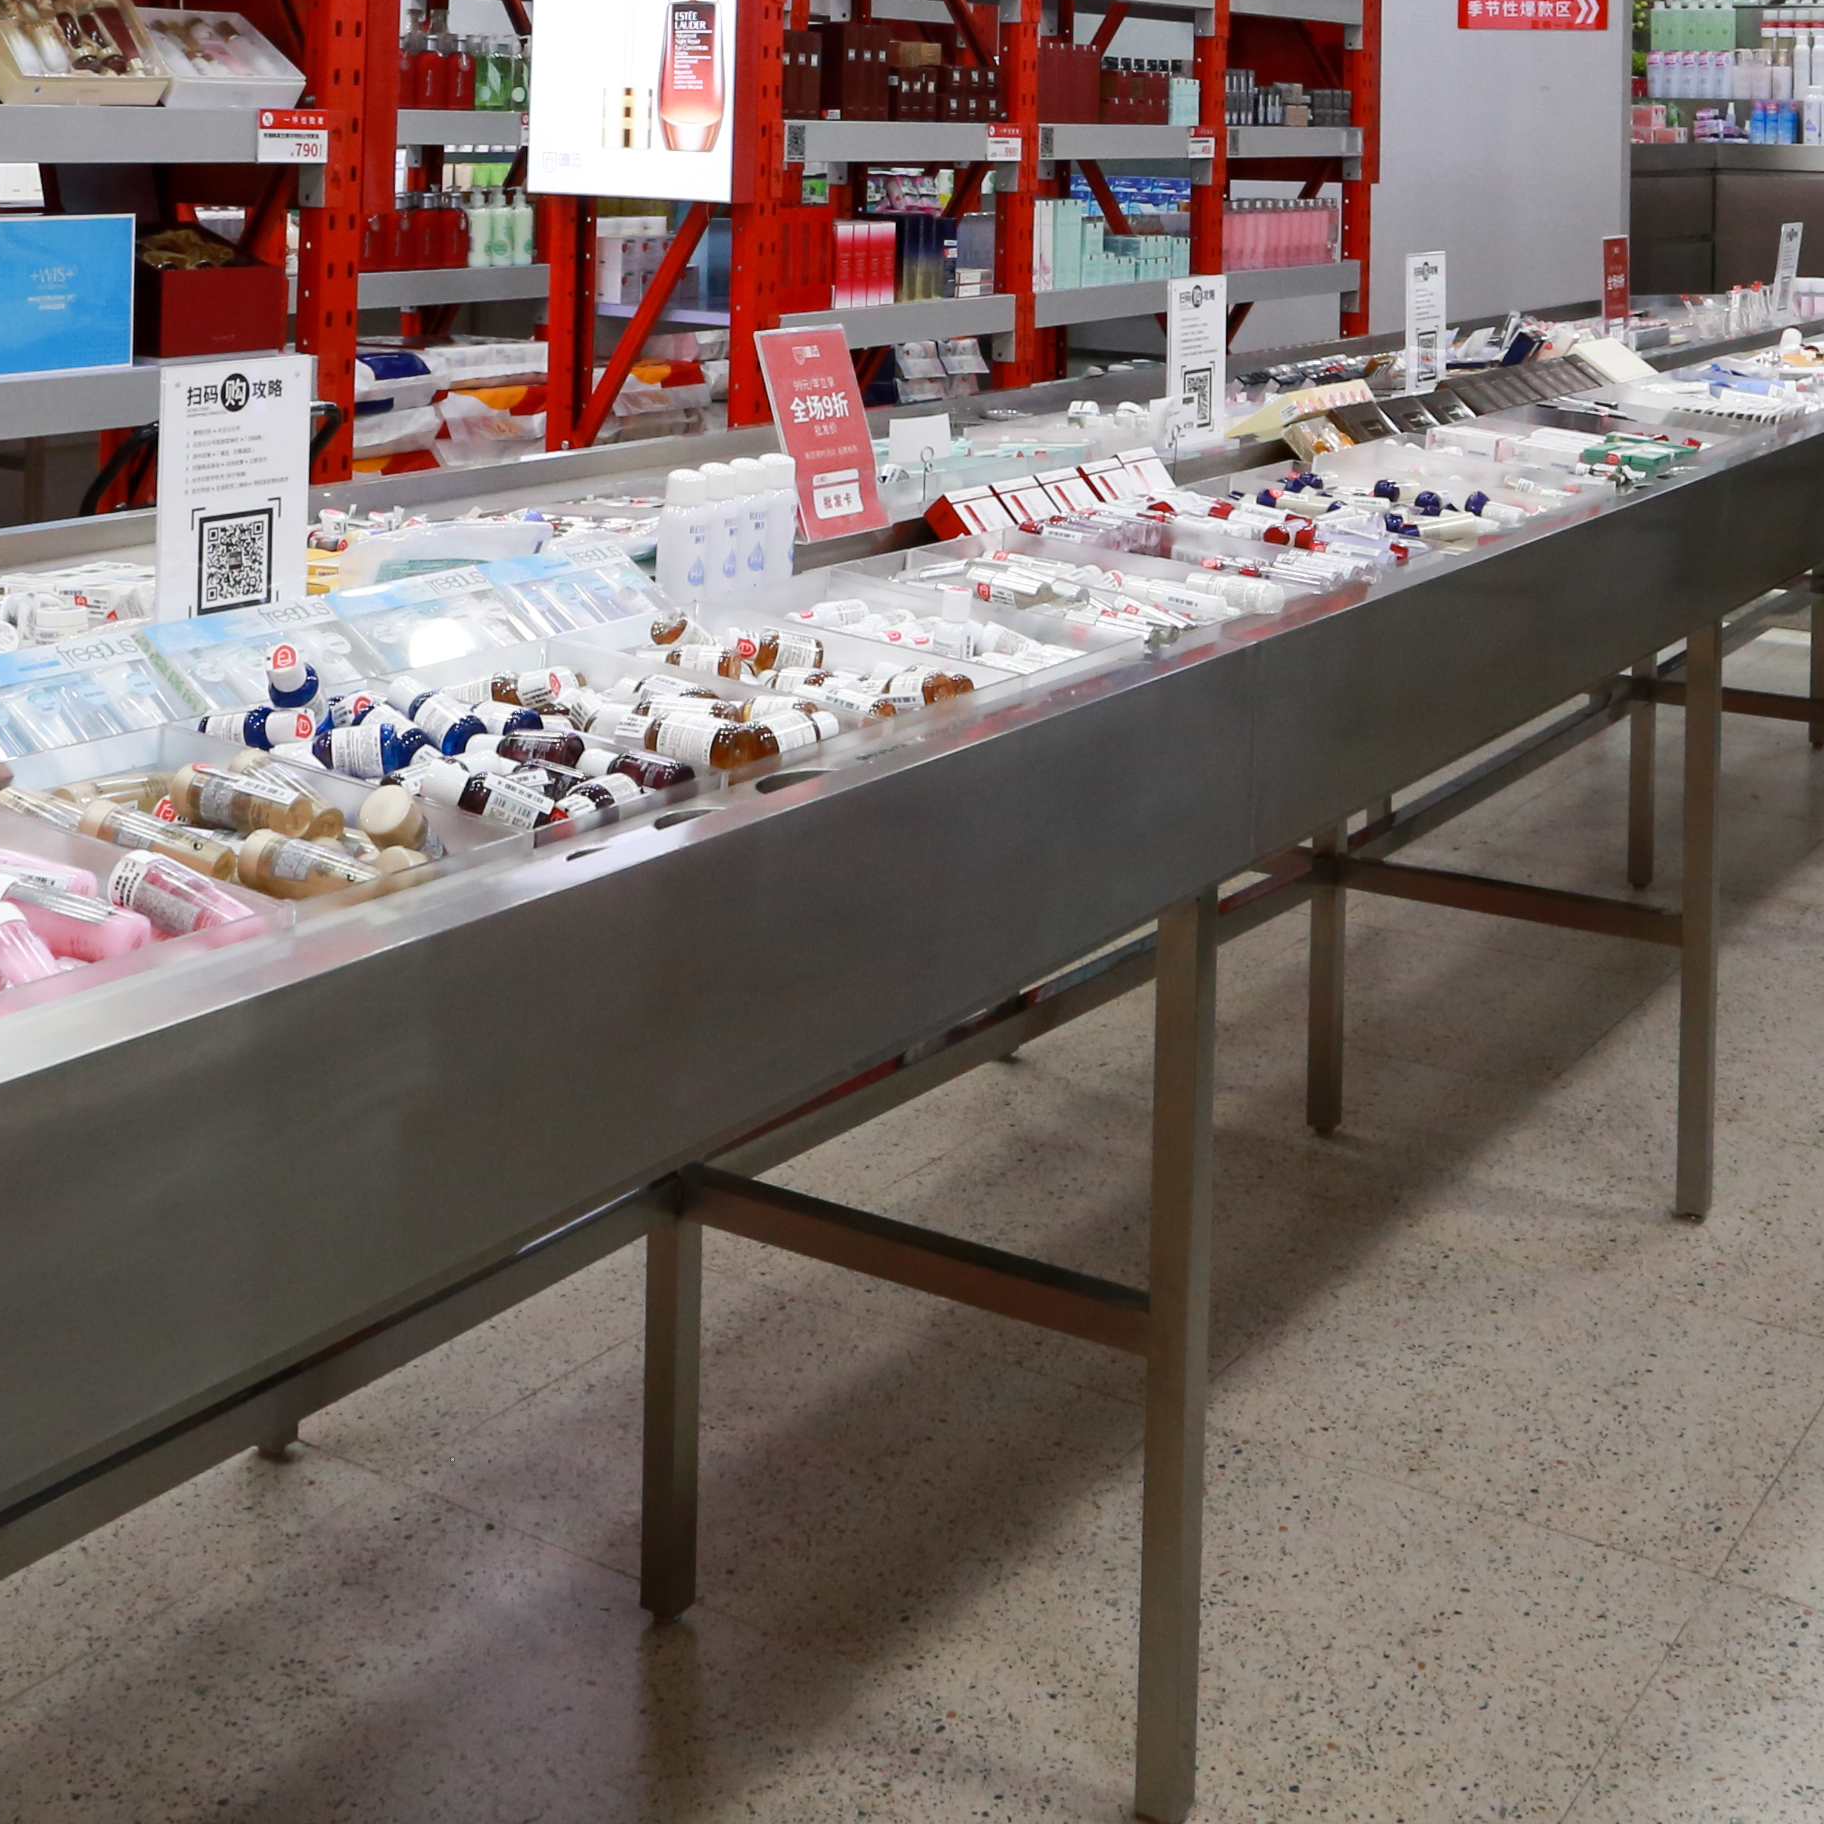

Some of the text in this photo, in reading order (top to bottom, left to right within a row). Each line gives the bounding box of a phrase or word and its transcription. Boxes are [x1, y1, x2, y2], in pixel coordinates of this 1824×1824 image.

[1468, 0, 1572, 18] 季节性爆款区
[674, 21, 707, 30] LAUDER
[187, 379, 283, 407] 扫码购攻略
[790, 391, 850, 424] 全场9折
[823, 492, 853, 510] 批发卡
